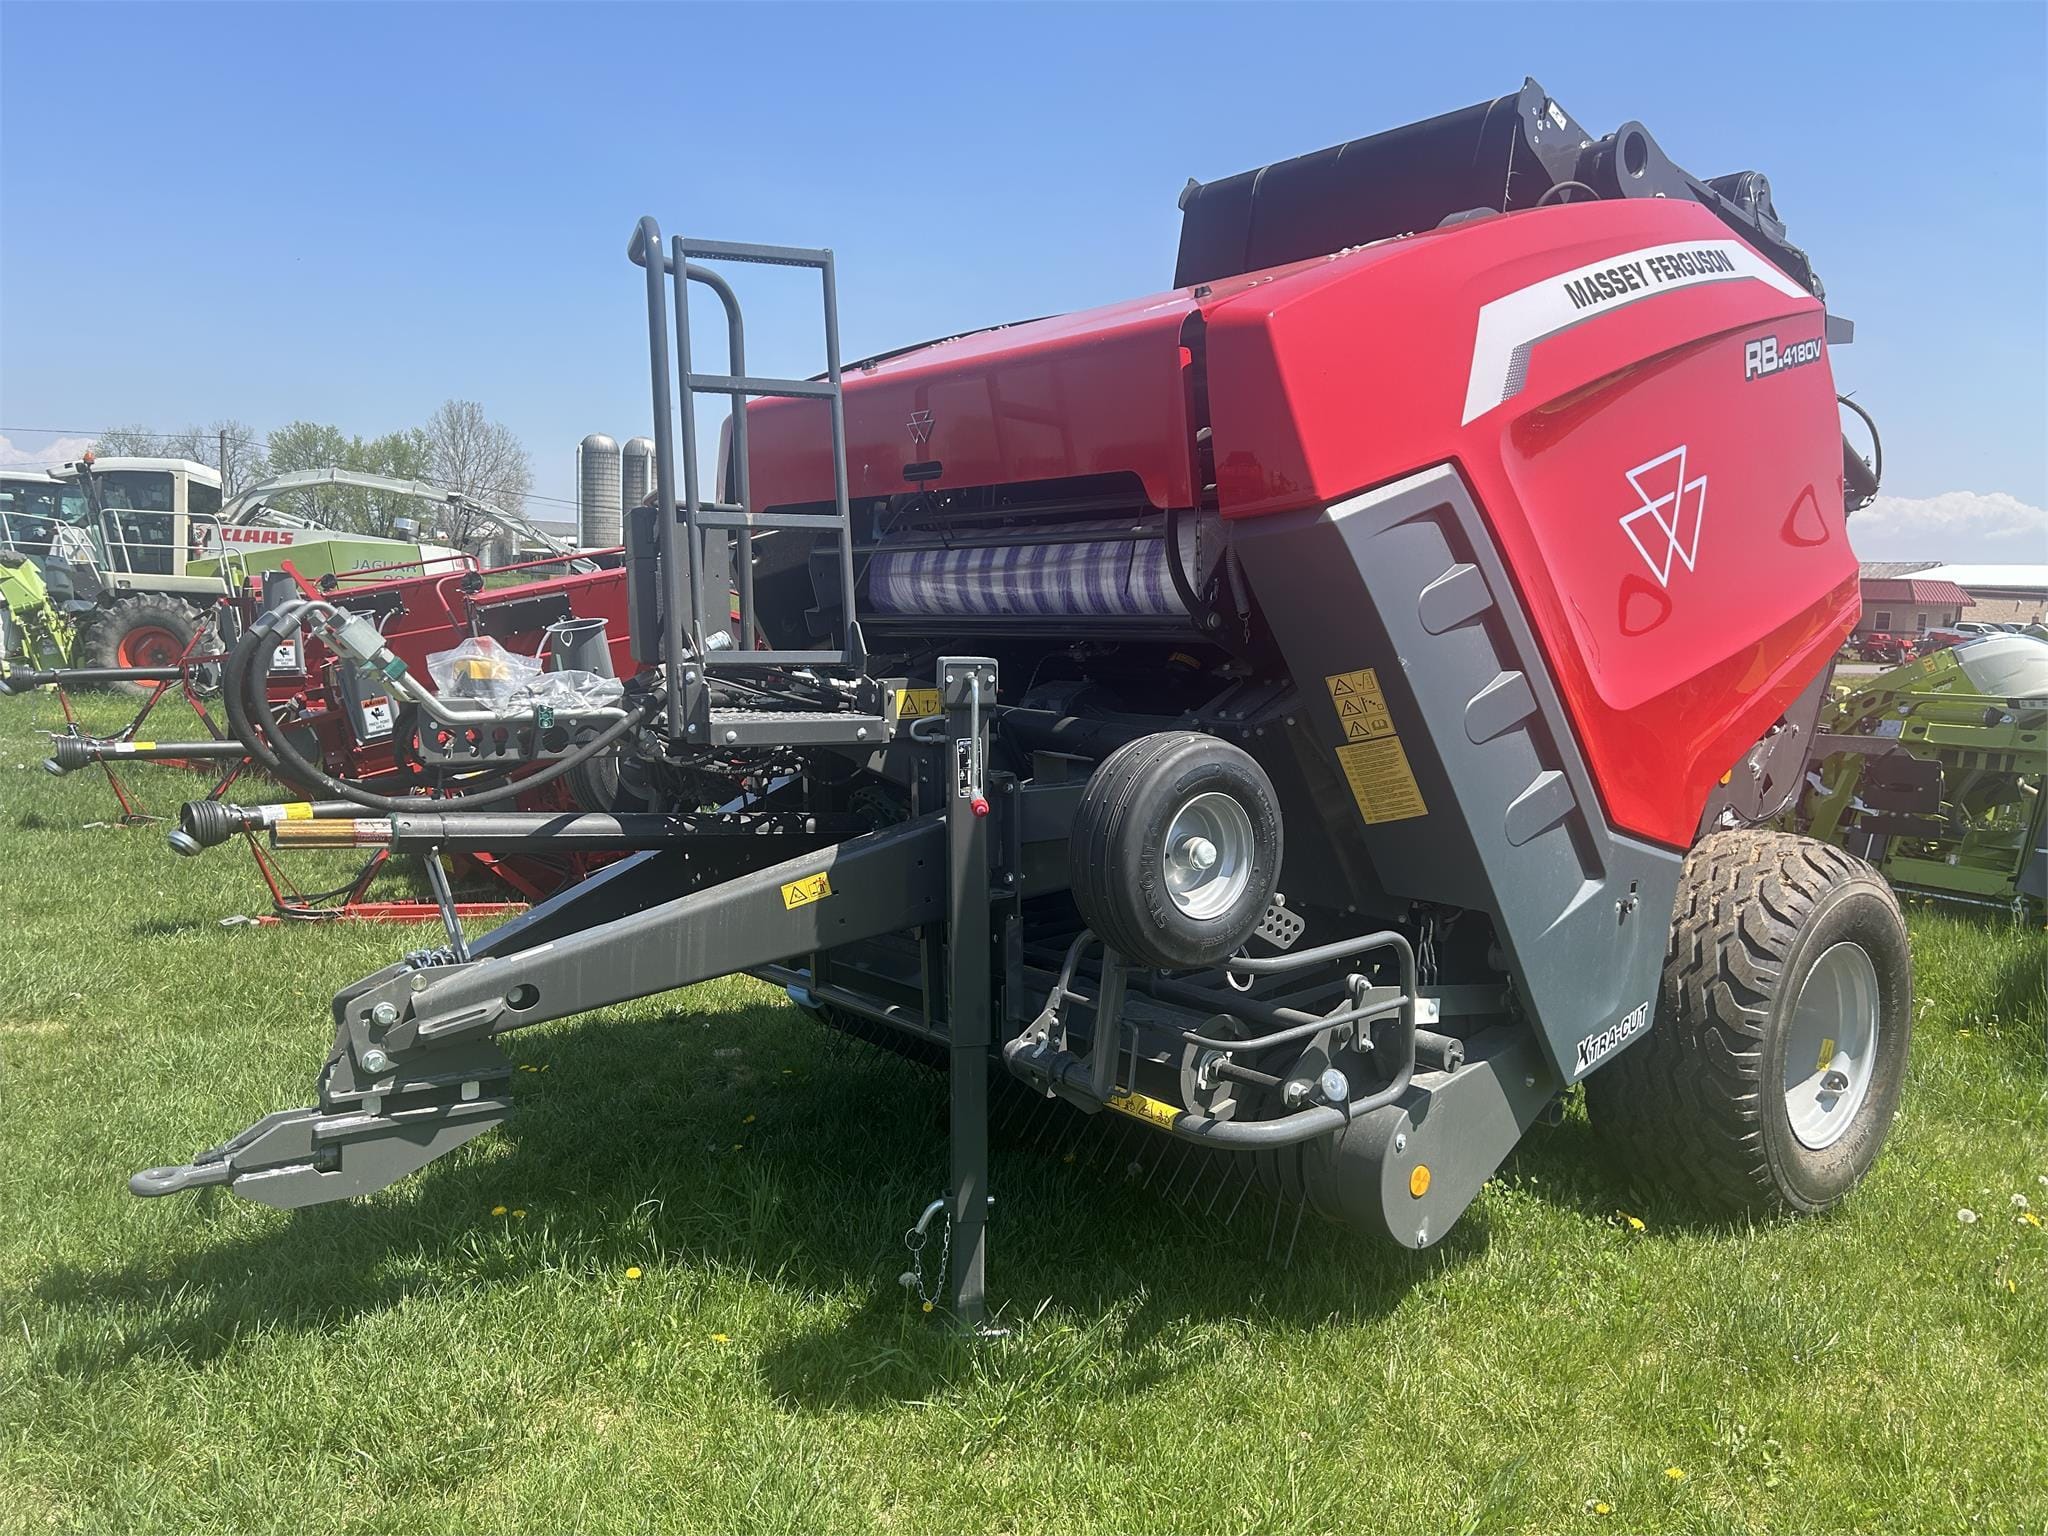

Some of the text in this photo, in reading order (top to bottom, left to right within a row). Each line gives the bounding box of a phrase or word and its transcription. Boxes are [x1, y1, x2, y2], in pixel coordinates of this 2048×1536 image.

[1563, 249, 1736, 309] MASSEY FERGUSON
[221, 528, 294, 545] CLAAS
[351, 559, 417, 573] JAGUAR
[1575, 1001, 1648, 1073] XTRA-CUT
